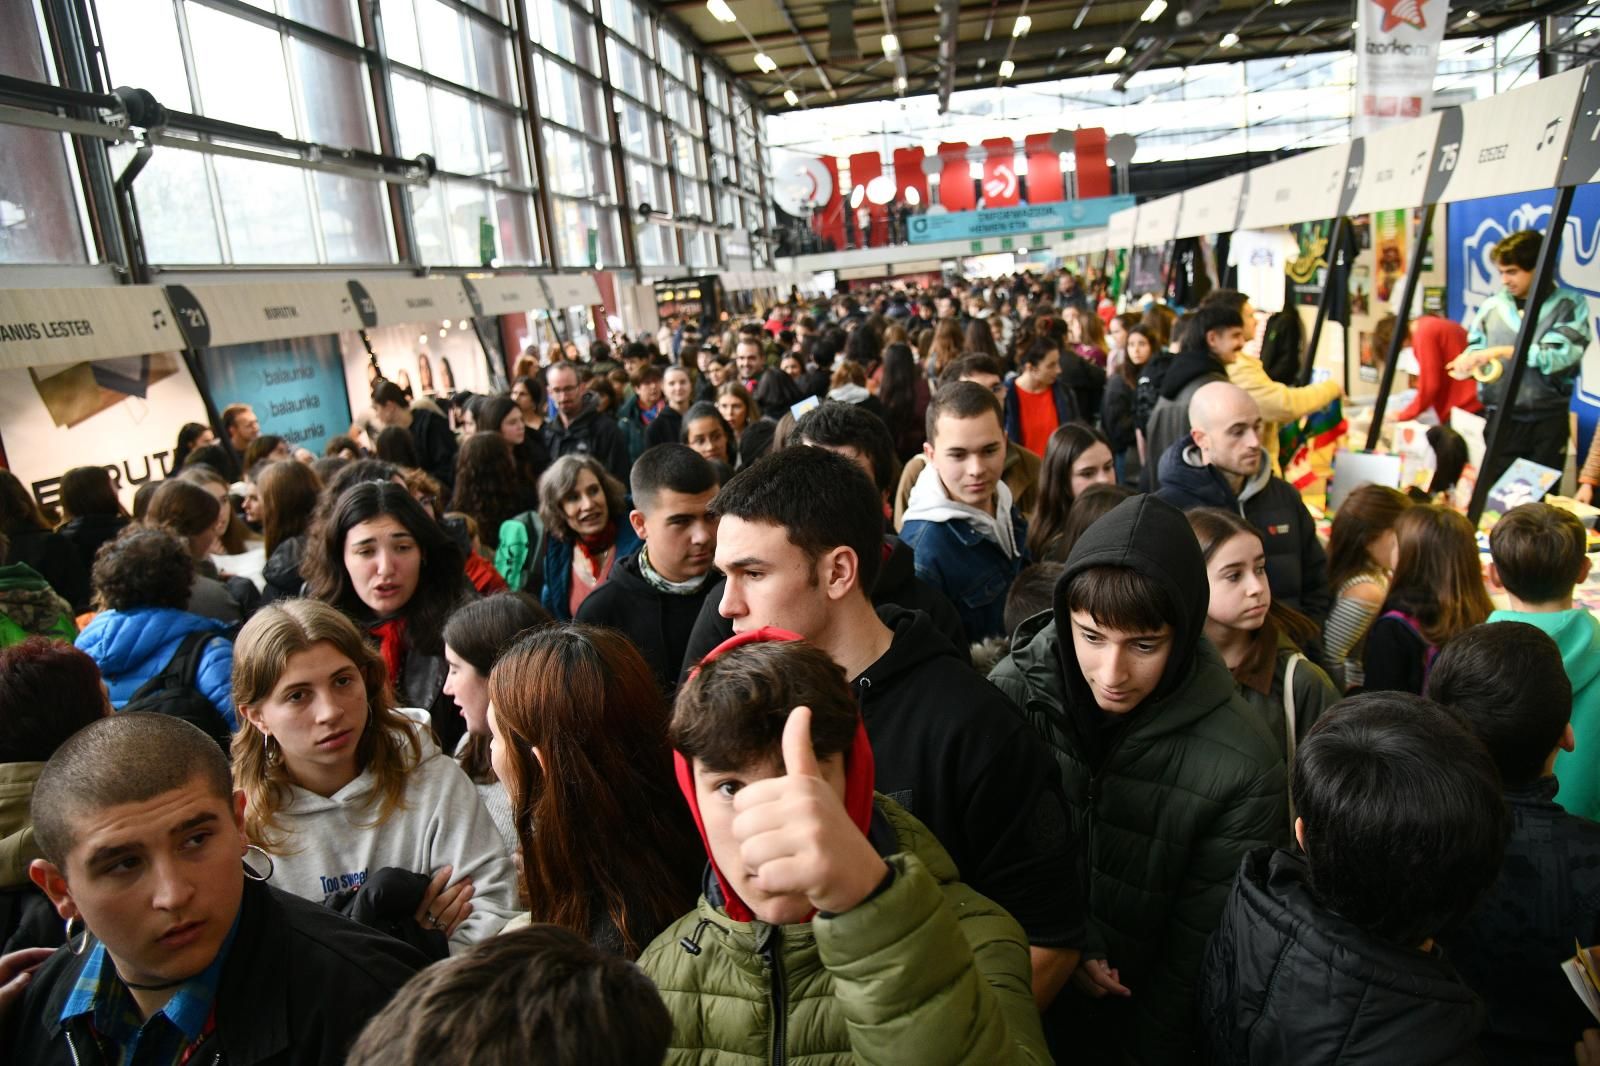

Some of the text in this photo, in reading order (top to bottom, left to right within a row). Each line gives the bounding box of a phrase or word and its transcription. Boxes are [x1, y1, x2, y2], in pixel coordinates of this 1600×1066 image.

[1438, 142, 1459, 172] 75
[0, 319, 94, 343] ANUS LESTER
[263, 366, 315, 386] balaunka
[270, 393, 321, 417] balaunka
[277, 422, 325, 444] alaunka
[320, 875, 340, 894] Too
